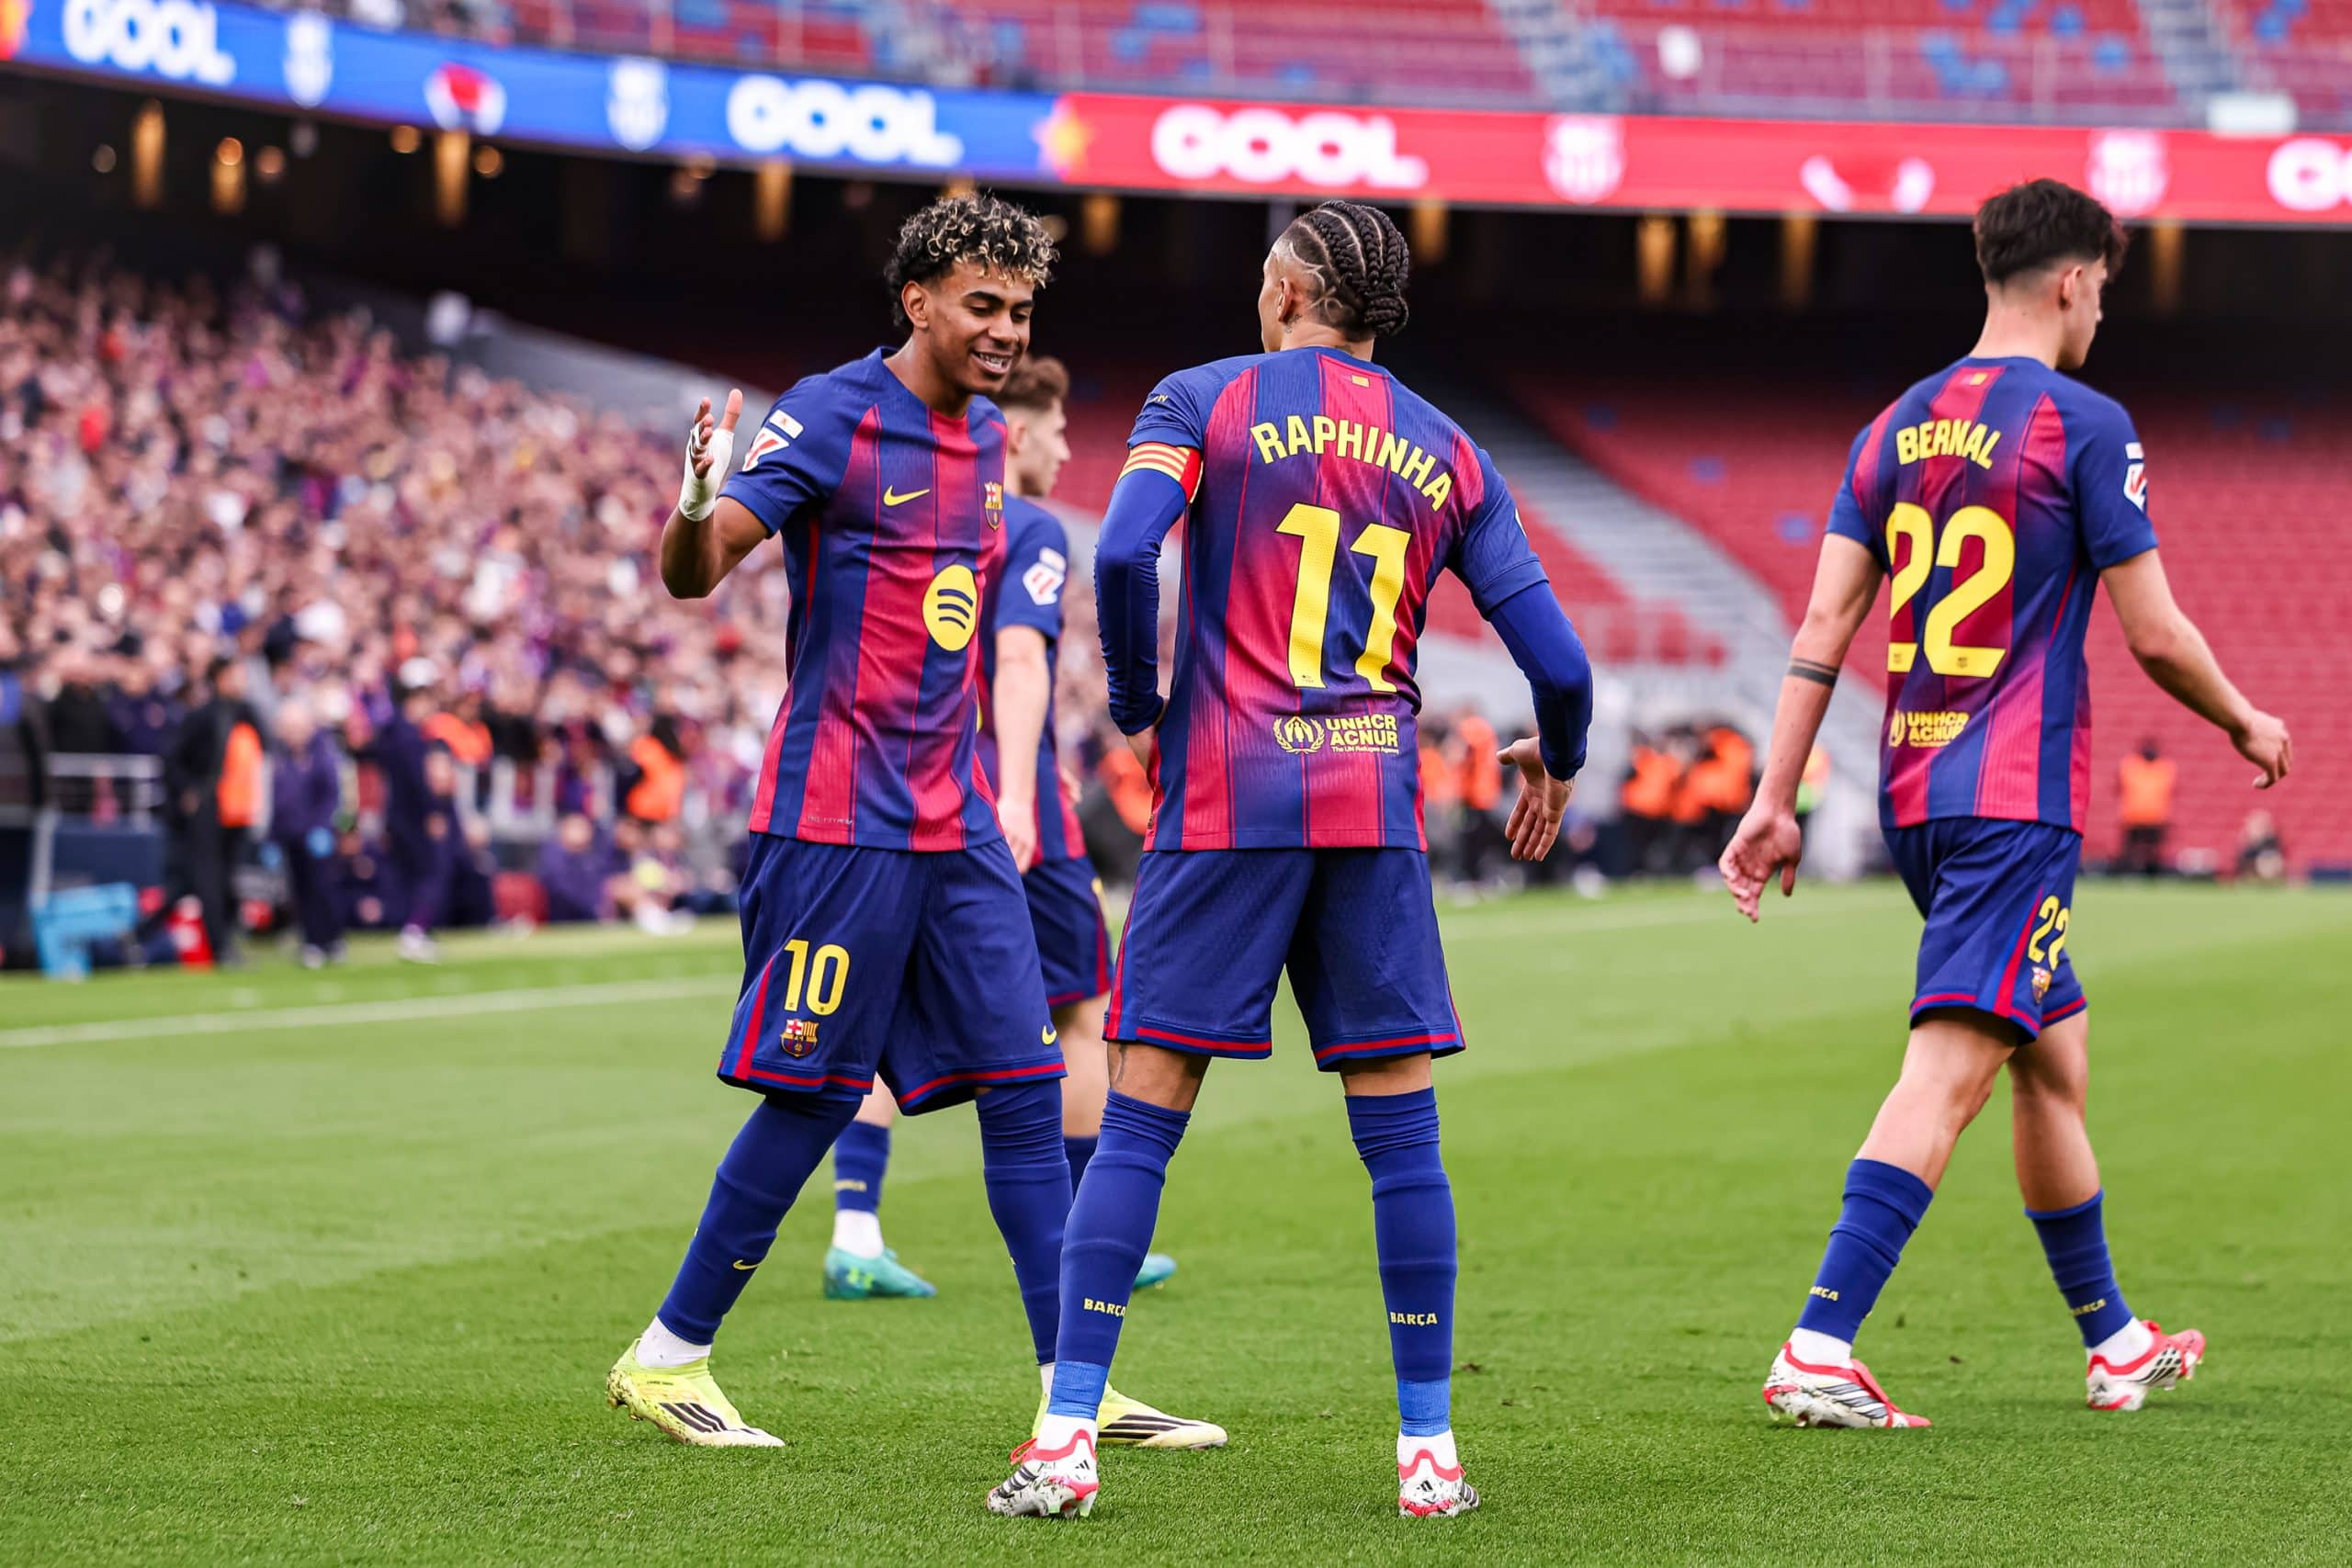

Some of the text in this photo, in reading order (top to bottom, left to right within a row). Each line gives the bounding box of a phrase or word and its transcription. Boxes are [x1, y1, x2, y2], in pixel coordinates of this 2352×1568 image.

[727, 73, 964, 168] GOOL
[1151, 104, 1429, 189] GOOL
[1250, 415, 1453, 512] RAPHINHA
[1895, 419, 2001, 470] BERNAL
[1275, 502, 1411, 693] 11
[1885, 502, 2016, 678] 22
[1325, 714, 1397, 731] UNHCR
[1329, 729, 1398, 747] ACNUR
[2028, 895, 2070, 971] 22
[784, 939, 850, 1015] 10
[1084, 1298, 1126, 1317] BARÇA
[1390, 1312, 1438, 1326] BARÇA
